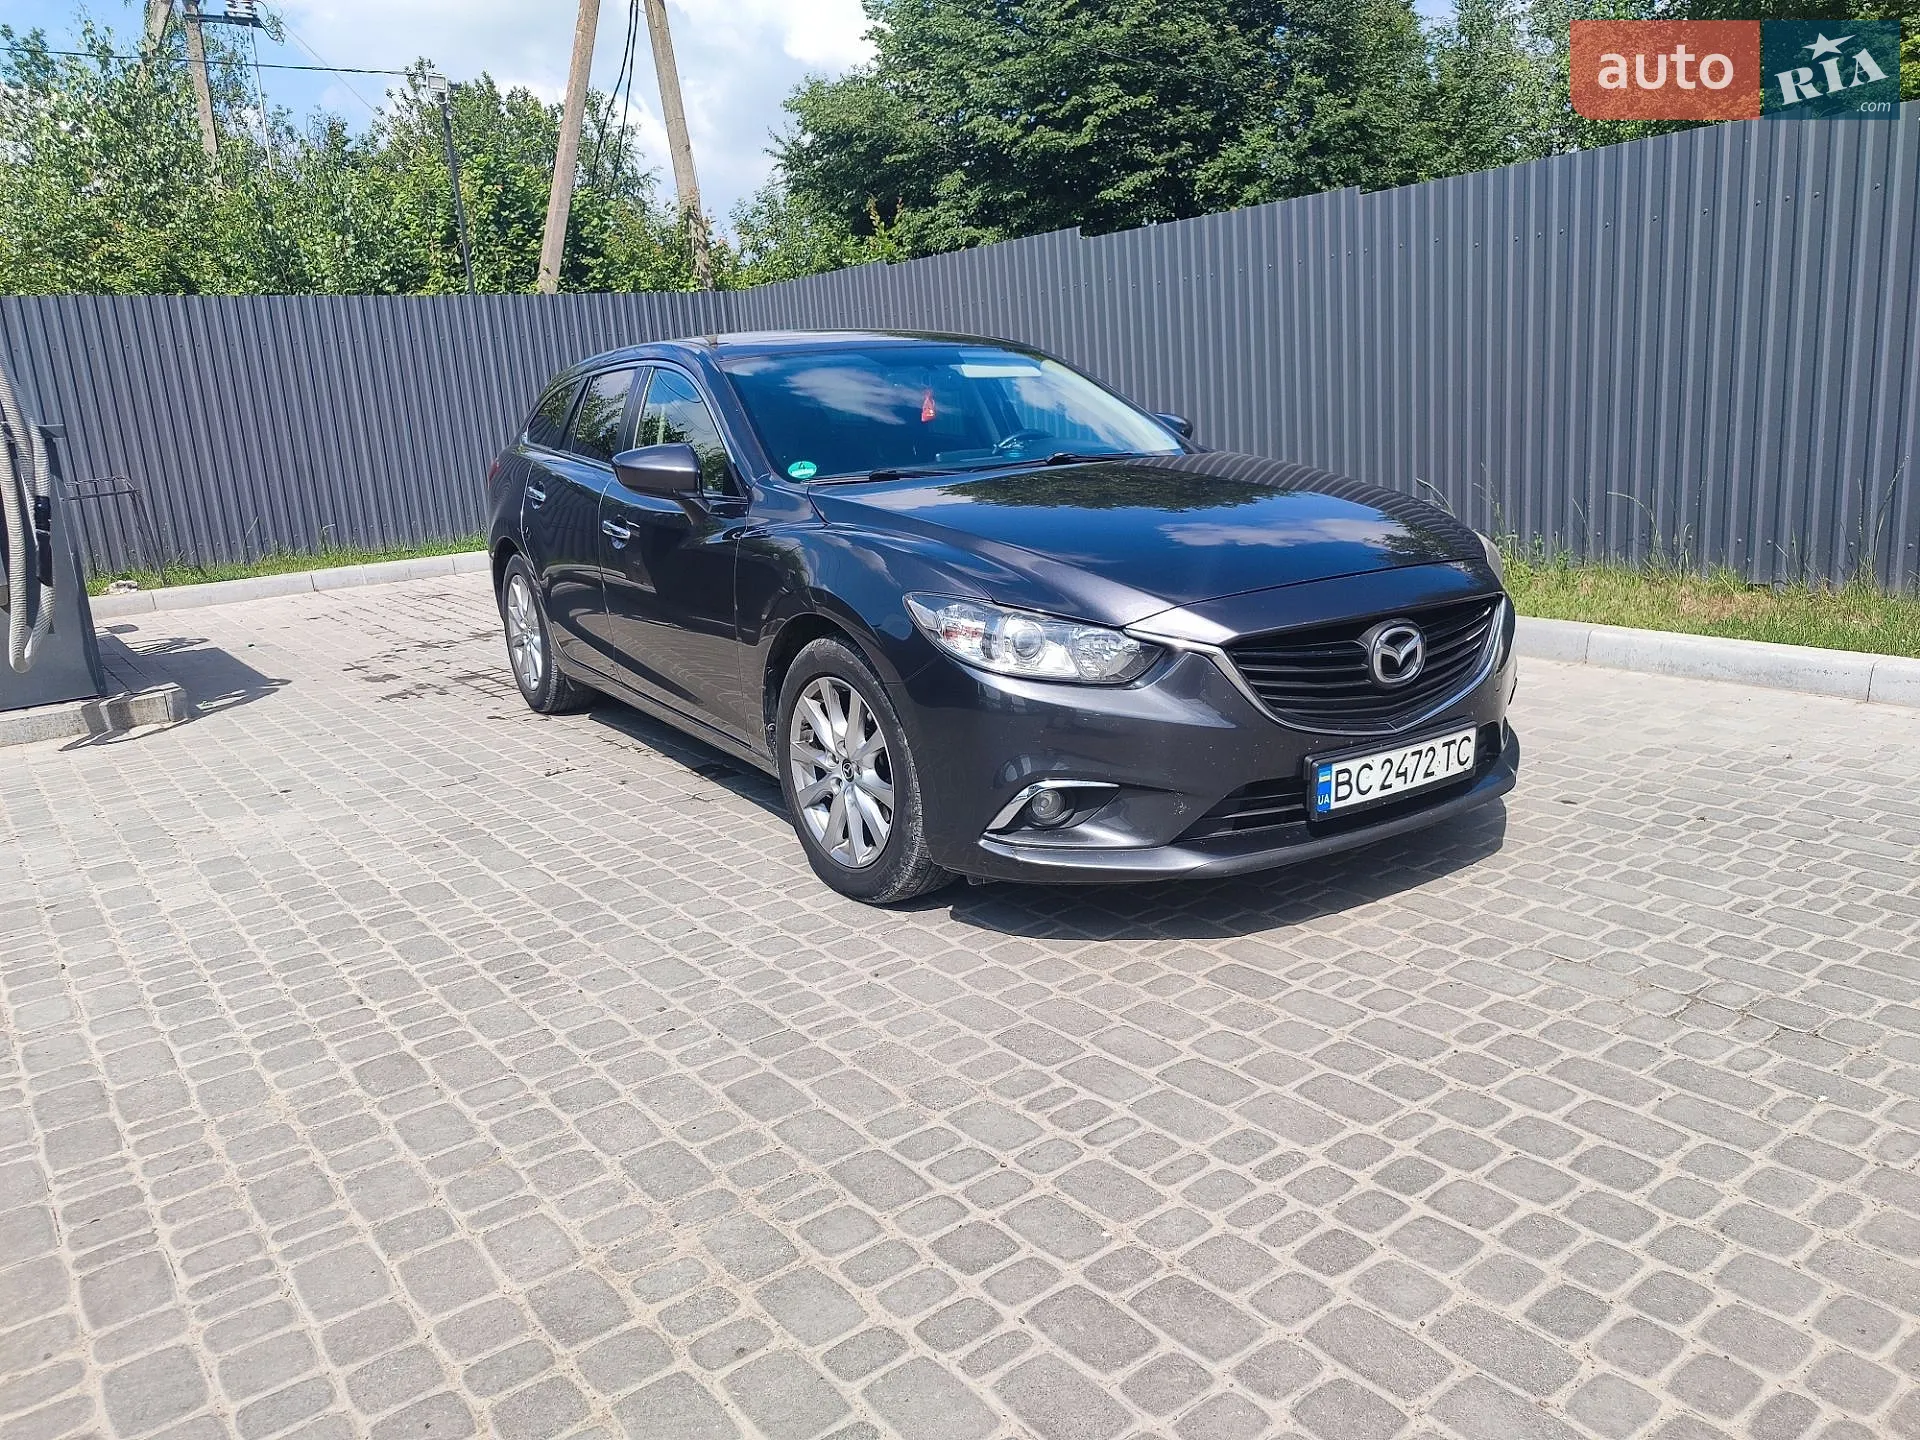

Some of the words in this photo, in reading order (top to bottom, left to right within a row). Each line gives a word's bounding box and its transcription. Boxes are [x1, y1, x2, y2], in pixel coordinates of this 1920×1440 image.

[1334, 763, 1373, 802] BC
[1379, 746, 1436, 791] 2472
[1442, 736, 1472, 771] TC
[1317, 794, 1330, 805] UA
